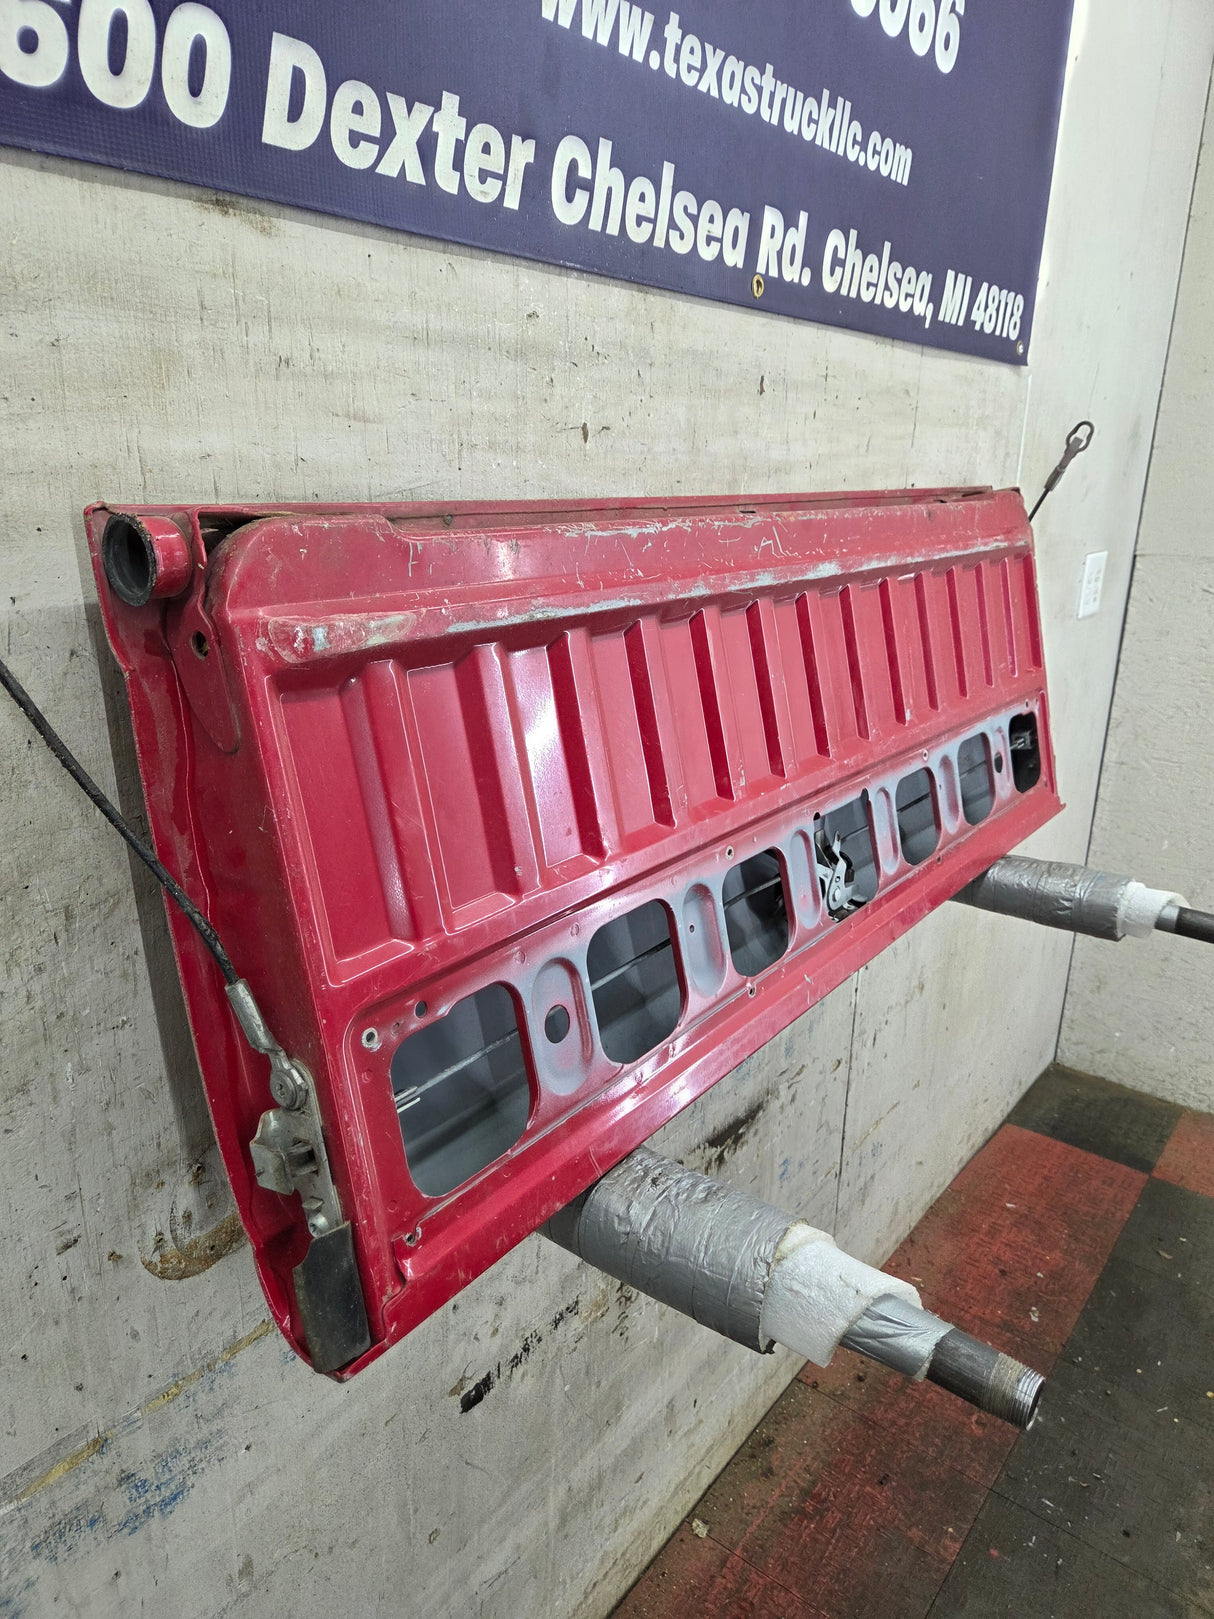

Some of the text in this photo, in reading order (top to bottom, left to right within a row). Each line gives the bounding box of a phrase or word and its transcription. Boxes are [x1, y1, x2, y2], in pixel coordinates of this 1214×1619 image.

[851, 0, 966, 74] 66
[261, 31, 536, 211] Dexter
[550, 134, 751, 269] Chelsea
[755, 204, 812, 287] Rd.
[821, 228, 934, 329] Chelsea,
[937, 269, 973, 327] MI
[970, 281, 1025, 341] 48118
